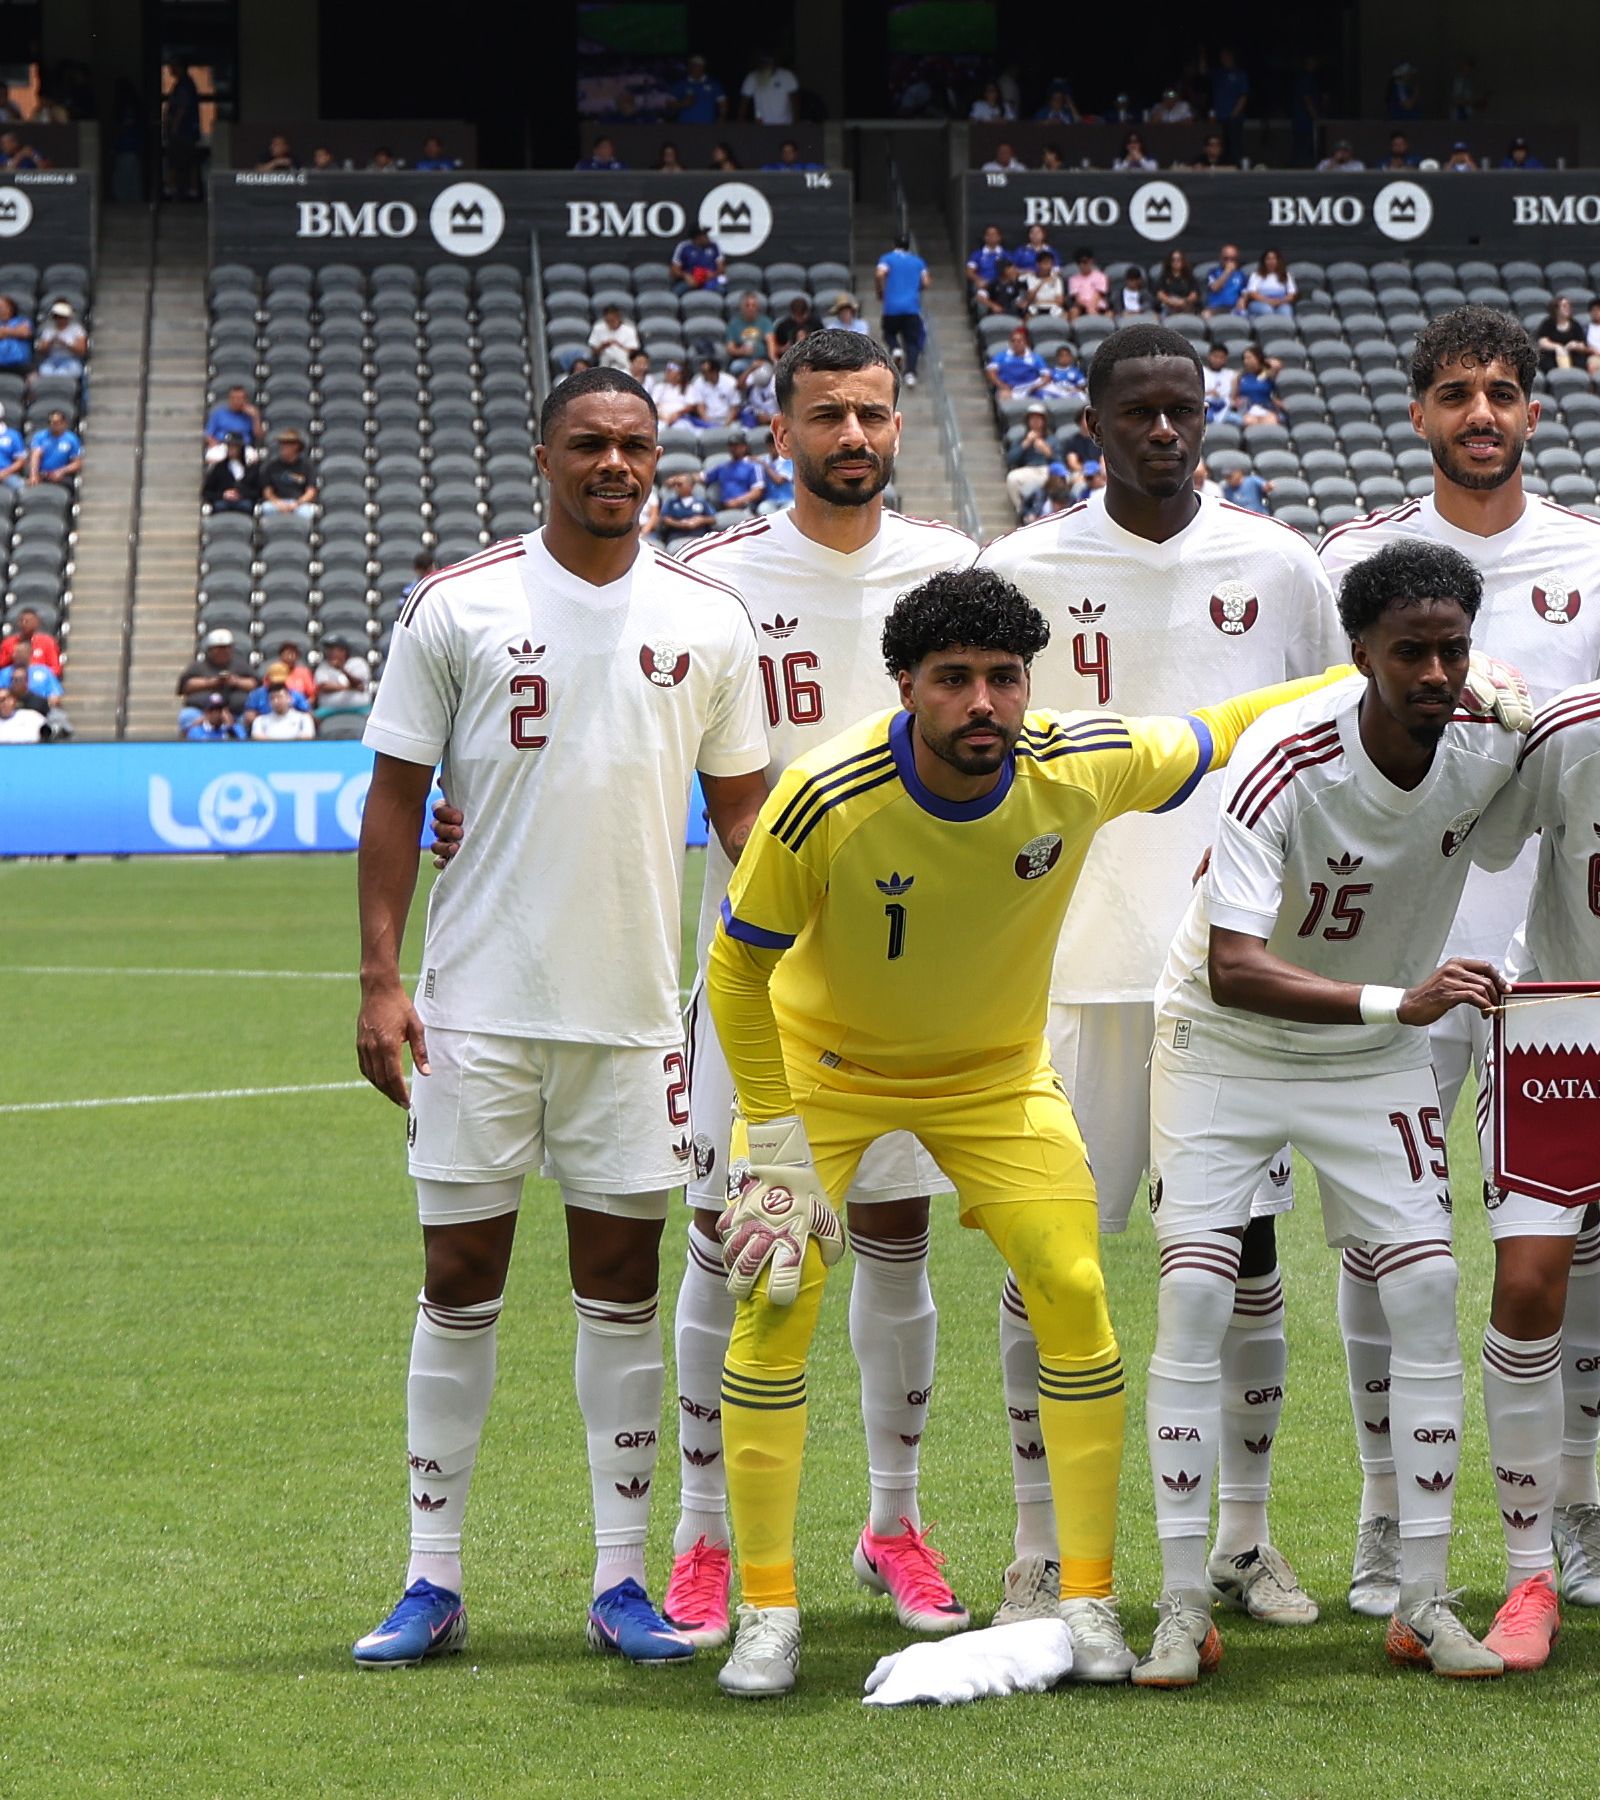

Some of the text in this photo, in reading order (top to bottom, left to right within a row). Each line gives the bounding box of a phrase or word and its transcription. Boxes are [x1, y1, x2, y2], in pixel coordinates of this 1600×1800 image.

[805, 172, 832, 188] 114
[296, 201, 418, 238] BMO
[565, 201, 687, 238] BMO
[1023, 197, 1120, 226] BMO
[1268, 197, 1363, 226] BMO
[1221, 620, 1245, 634] QFA
[650, 671, 675, 687] QFA
[1072, 631, 1113, 706] 4
[758, 650, 826, 728] 16
[508, 674, 550, 752] 2
[1026, 865, 1050, 880] QFA
[1297, 881, 1375, 942] 15
[884, 903, 907, 961] 1
[662, 1051, 691, 1128] 2
[1388, 1106, 1450, 1184] 15
[1244, 1386, 1284, 1406] QFA
[1365, 1378, 1391, 1394] QF
[678, 1395, 721, 1422] QFA
[1008, 1406, 1039, 1422] QF
[614, 1430, 656, 1448] QFA
[1158, 1426, 1201, 1442] QFA
[1413, 1428, 1457, 1444] QFA
[1495, 1466, 1537, 1487] QFA
